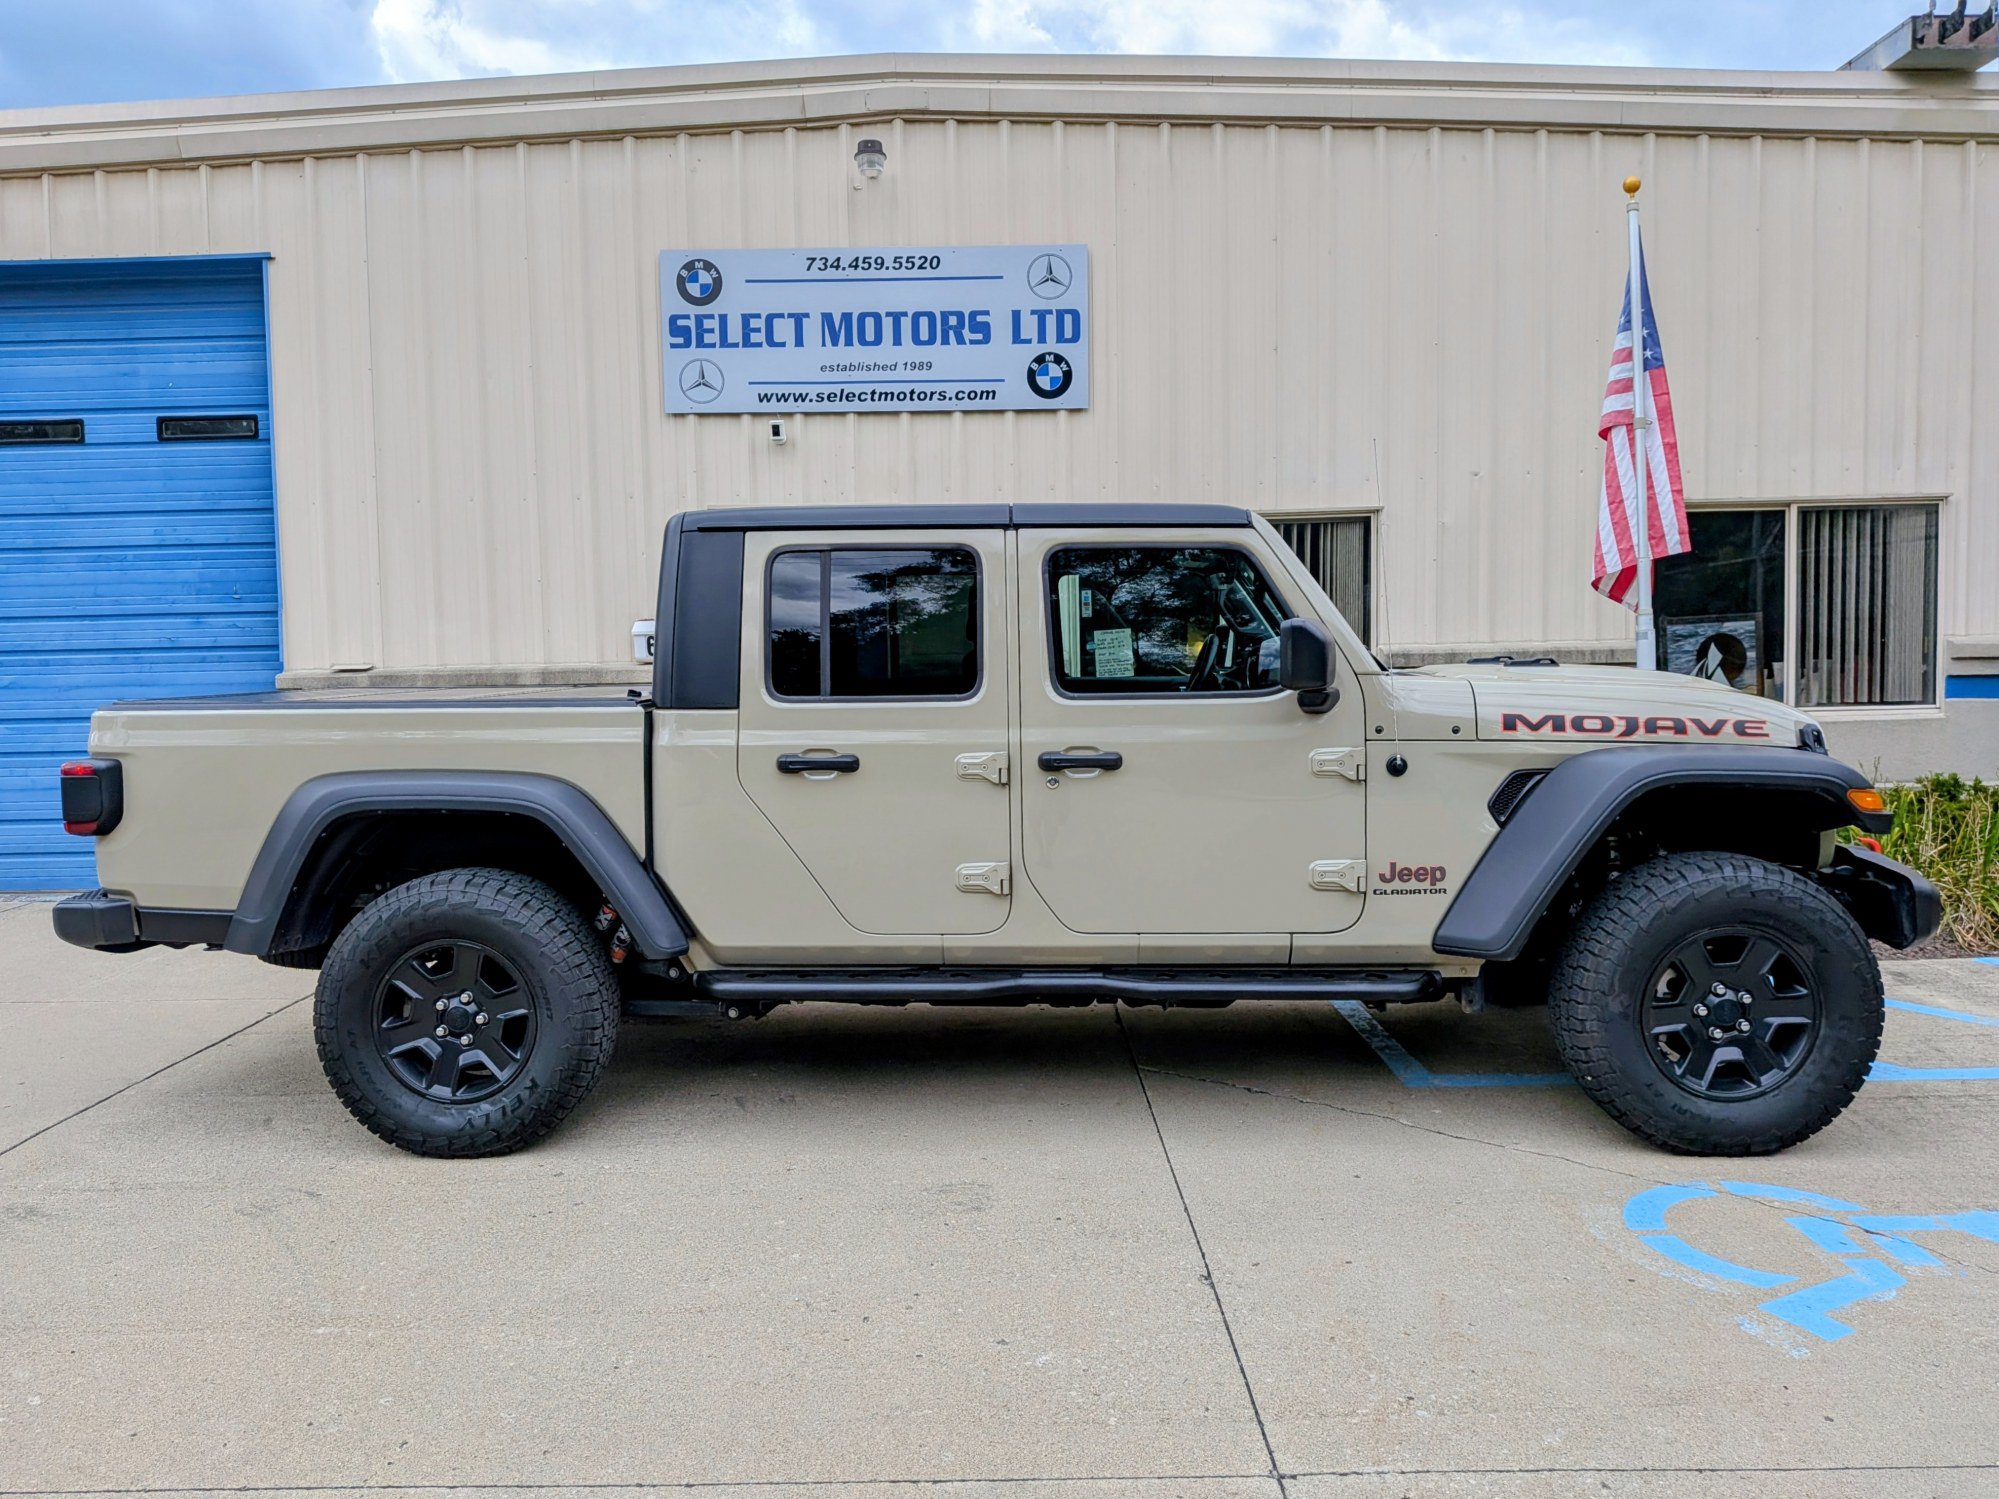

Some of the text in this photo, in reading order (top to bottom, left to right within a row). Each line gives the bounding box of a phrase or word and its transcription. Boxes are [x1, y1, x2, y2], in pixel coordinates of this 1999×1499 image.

[680, 261, 718, 278] BMW
[805, 255, 941, 272] 734.459.5520
[668, 308, 1081, 349] SELECT MOTORS LTD
[820, 360, 933, 374] established 1989
[1030, 354, 1070, 371] BMW
[757, 387, 997, 404] www.selectmotors.com
[1500, 712, 1771, 739] MOJAVE
[1378, 862, 1447, 886] Jeep
[1372, 887, 1448, 896] GLADIATOR
[459, 1075, 542, 1131] KELLY
